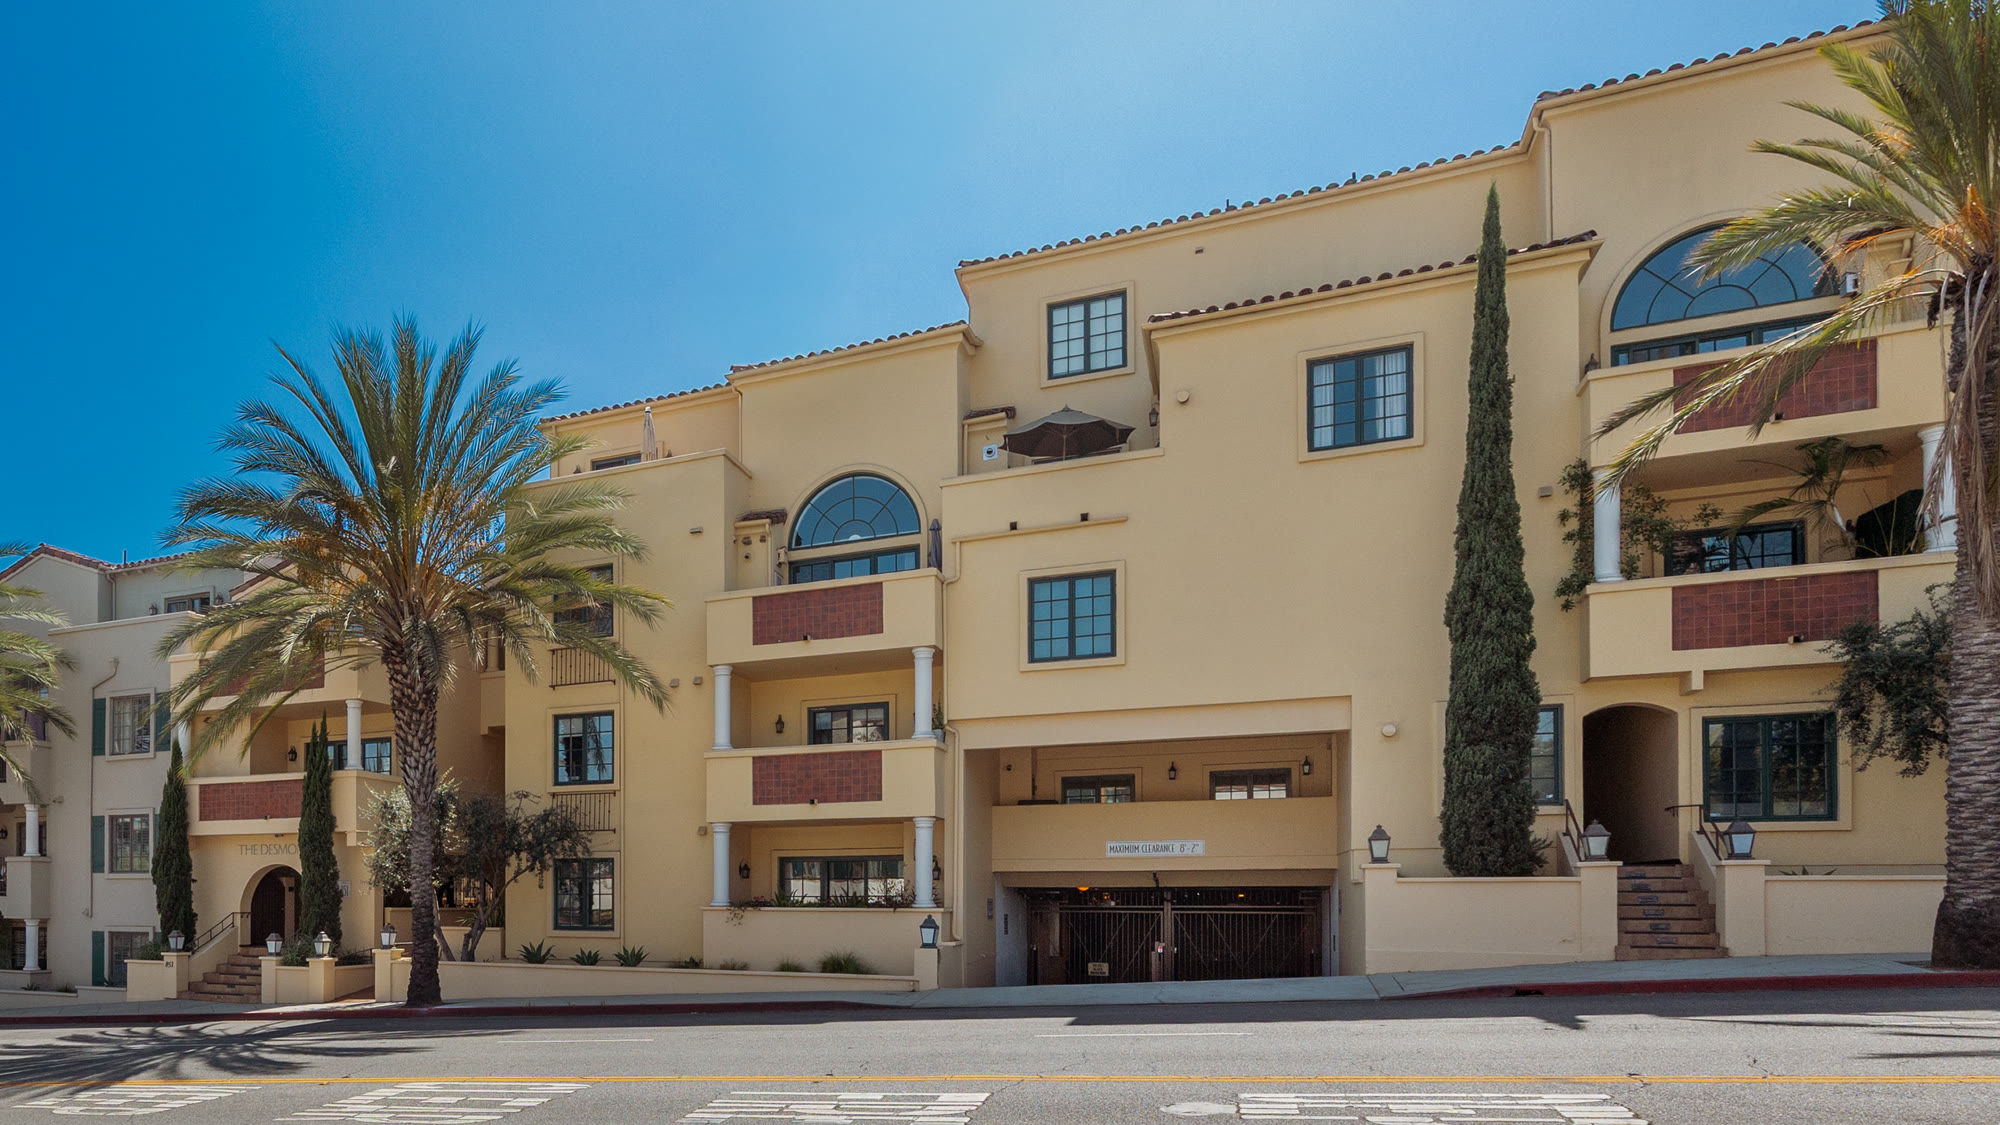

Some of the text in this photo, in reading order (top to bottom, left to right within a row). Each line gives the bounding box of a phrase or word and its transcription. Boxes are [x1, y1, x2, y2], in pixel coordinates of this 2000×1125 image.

[239, 844, 298, 856] THE DESMO
[1109, 844, 1140, 854] MAXIMUM
[1141, 843, 1175, 854] CLEARANCE
[12, 1084, 262, 1116] KEEP
[273, 1081, 592, 1125] CLEAR
[1238, 1093, 1650, 1125] DEP
